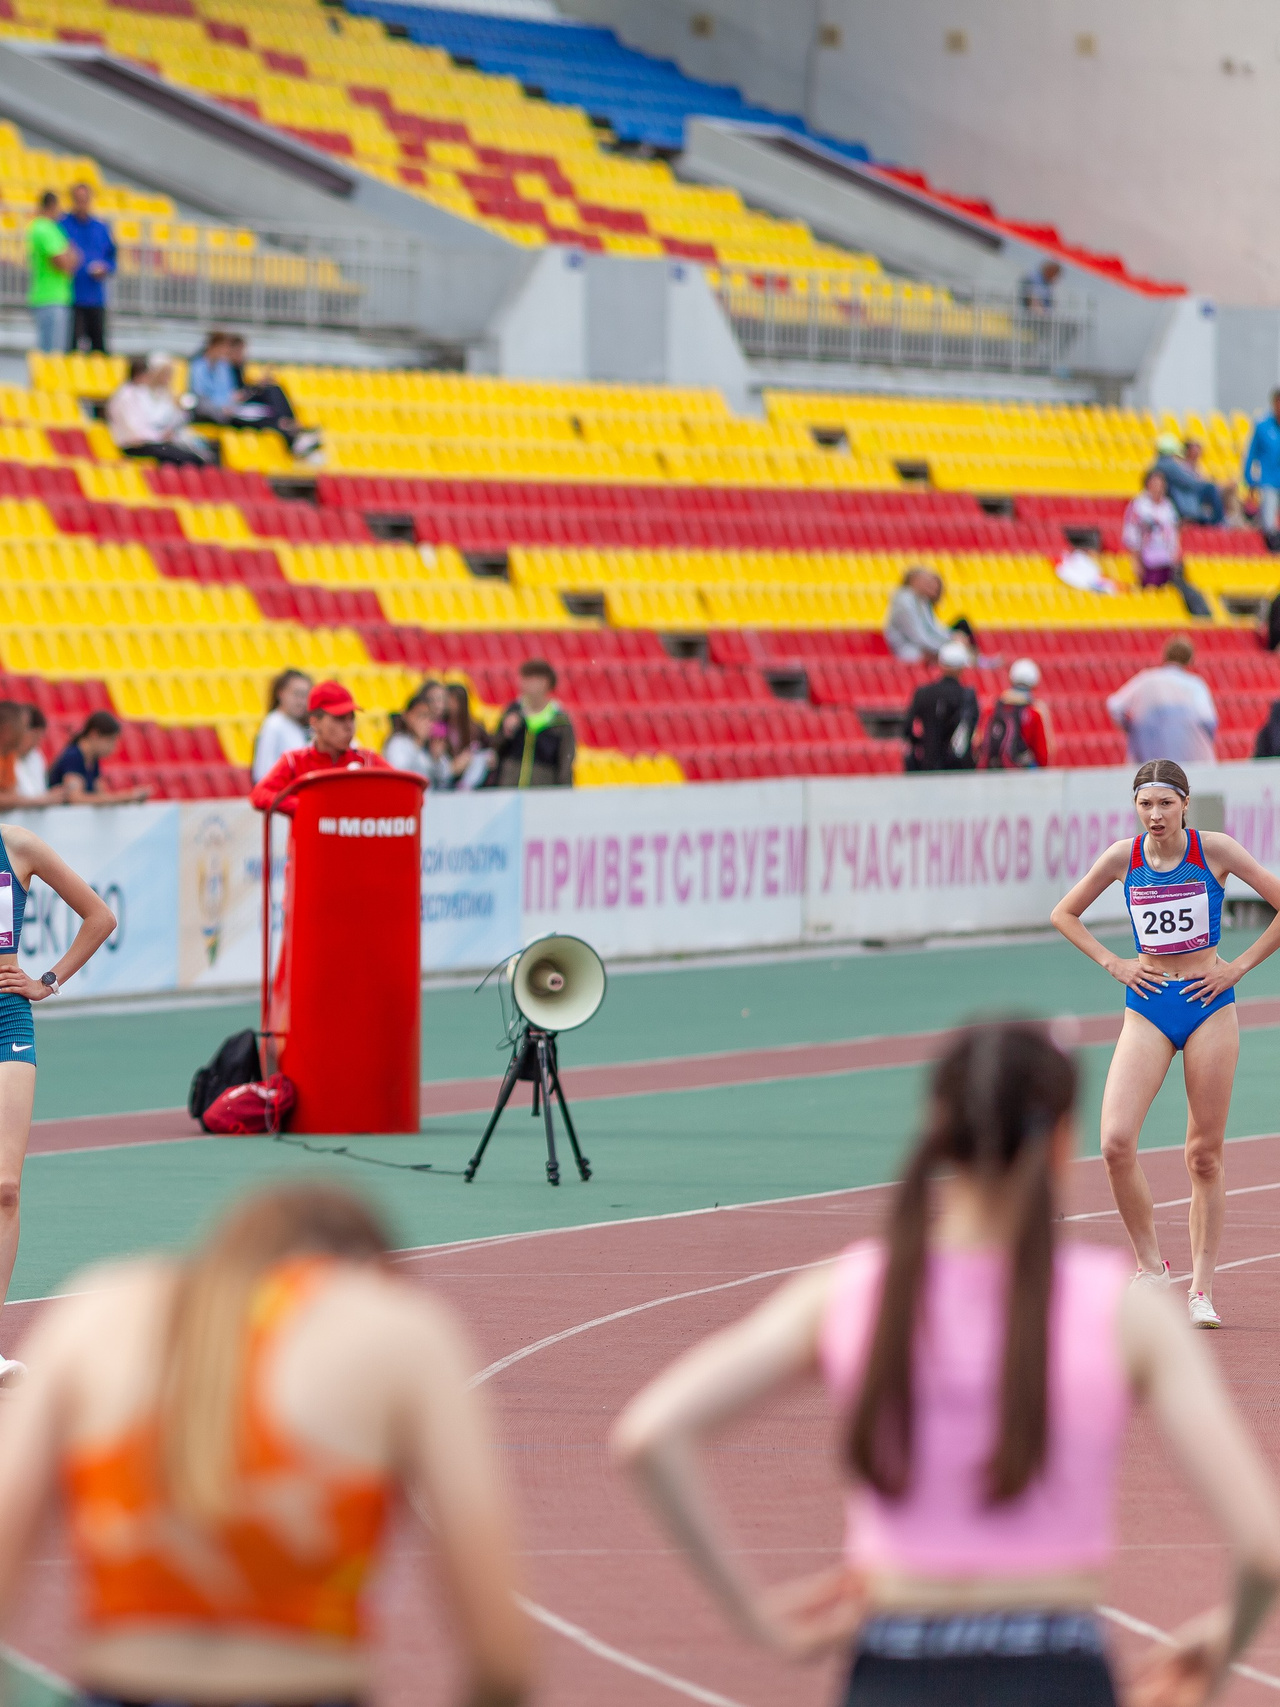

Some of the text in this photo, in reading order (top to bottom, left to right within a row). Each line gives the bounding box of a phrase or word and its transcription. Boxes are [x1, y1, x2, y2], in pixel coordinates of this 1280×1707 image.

[338, 815, 416, 837] MONDO
[524, 824, 808, 912] ПРИВЕТСТВУЕМ
[820, 814, 1032, 893] УЧАСТНИКОВ
[1142, 908, 1194, 935] 285
